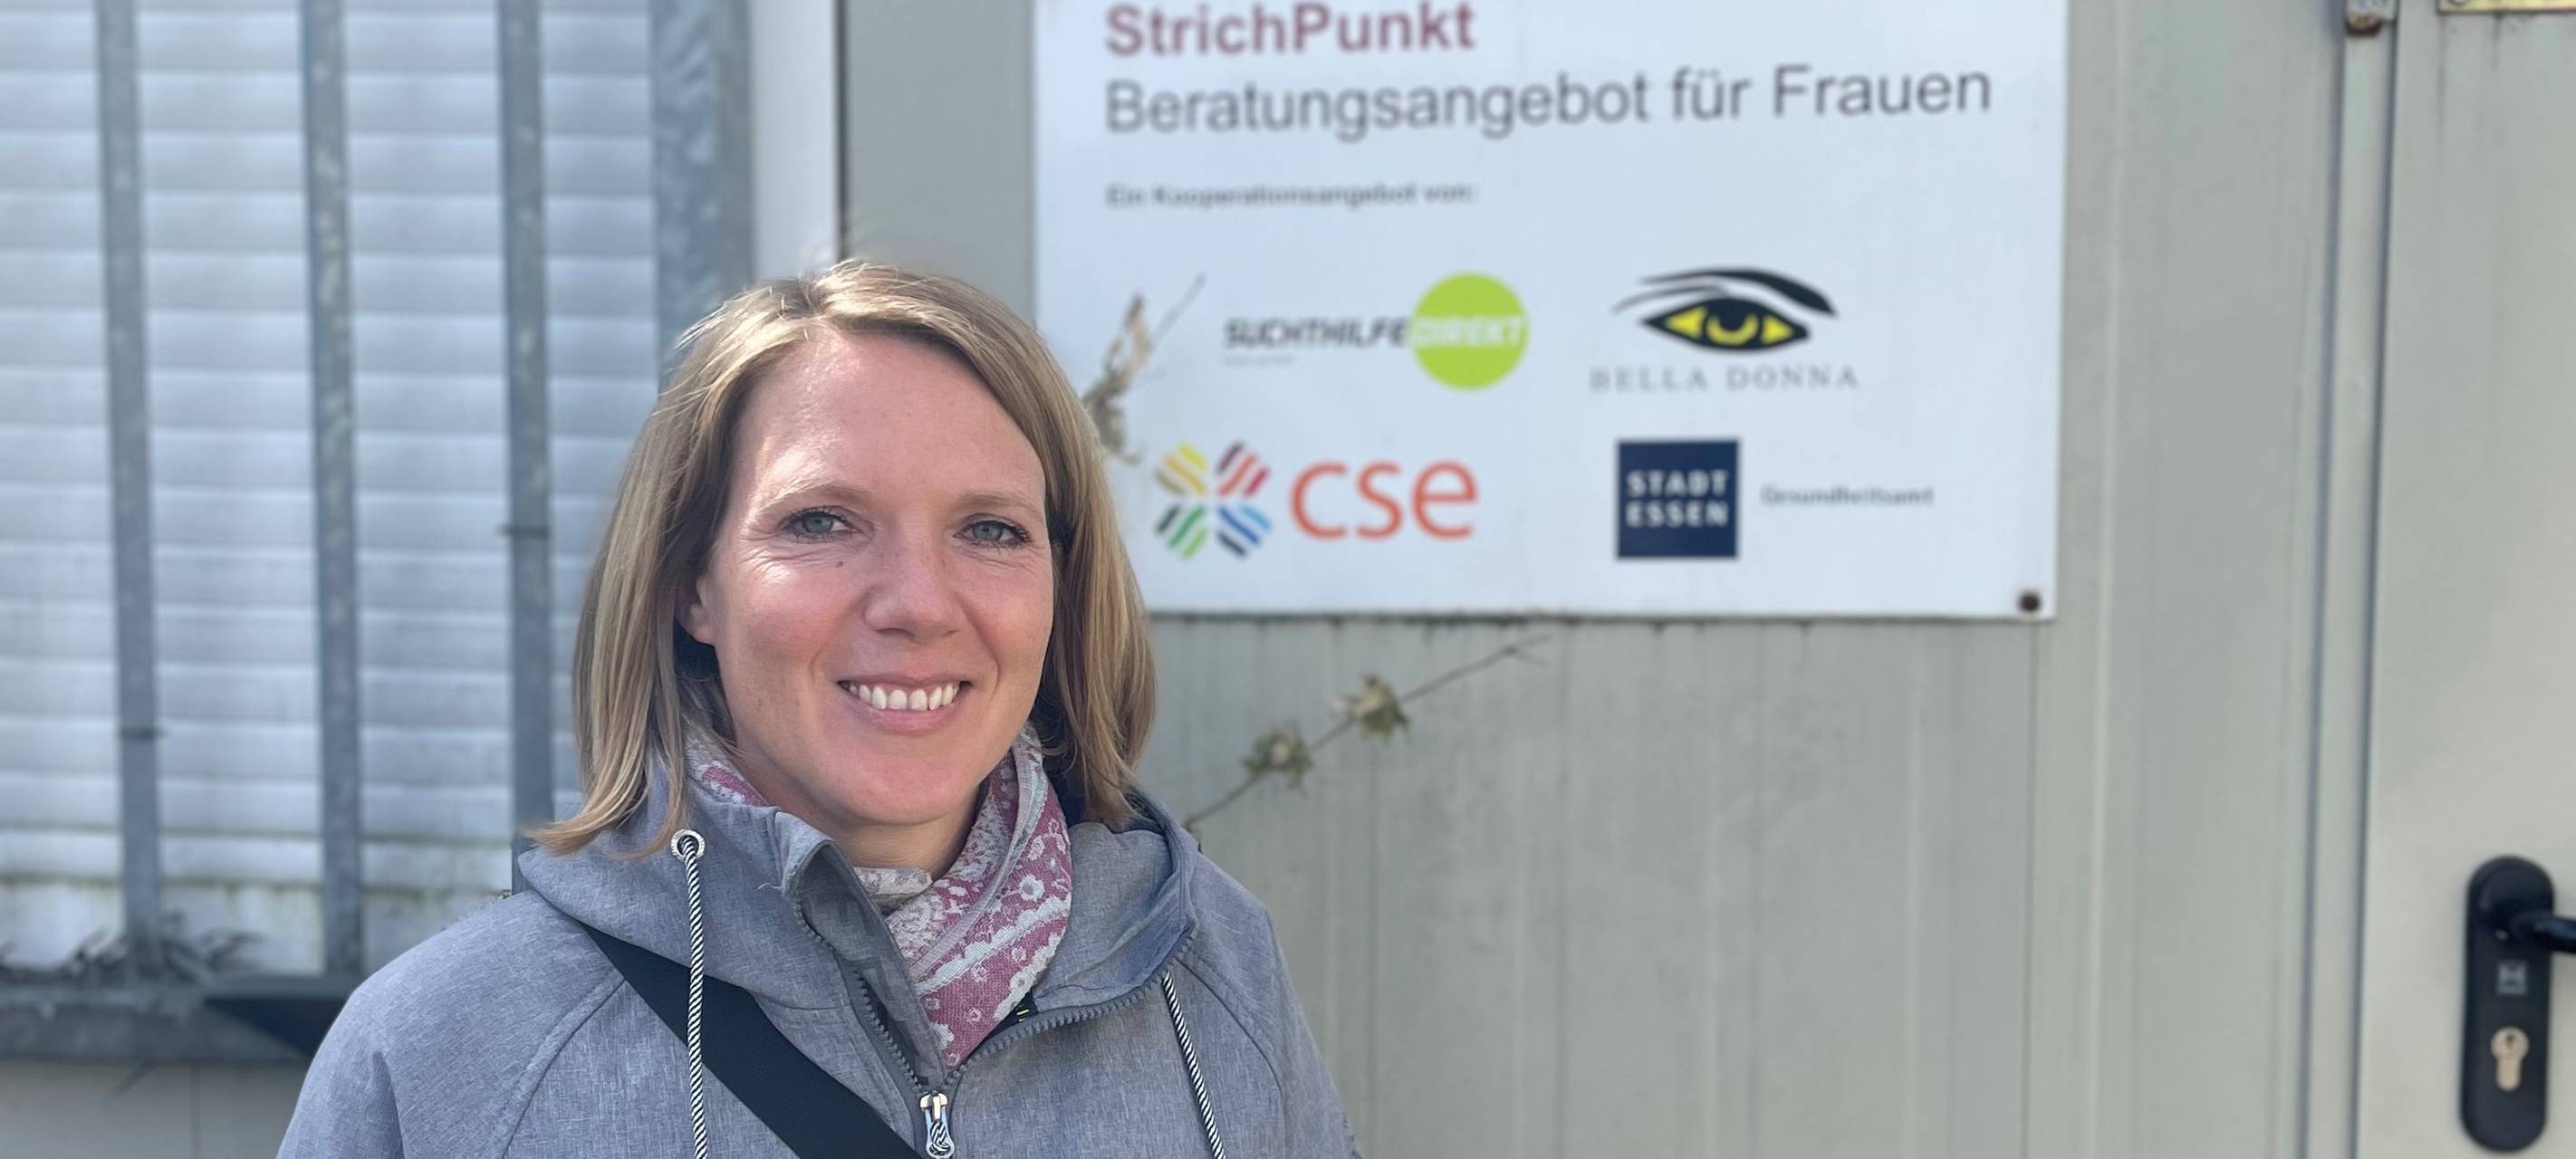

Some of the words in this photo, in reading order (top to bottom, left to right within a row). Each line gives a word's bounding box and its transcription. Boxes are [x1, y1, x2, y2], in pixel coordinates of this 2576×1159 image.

[1106, 0, 1476, 55] StrichPunkt
[1106, 72, 1649, 142] Beratungsangebot
[1669, 65, 1750, 121] für
[1773, 63, 1992, 116] Frauen
[1106, 183, 1144, 208] Ein
[1589, 366, 1710, 393] BELLA
[1725, 364, 1860, 391] DONNA
[1627, 469, 1729, 498] STADT
[1290, 459, 1478, 541] cse
[1627, 500, 1729, 527] ESSEN
